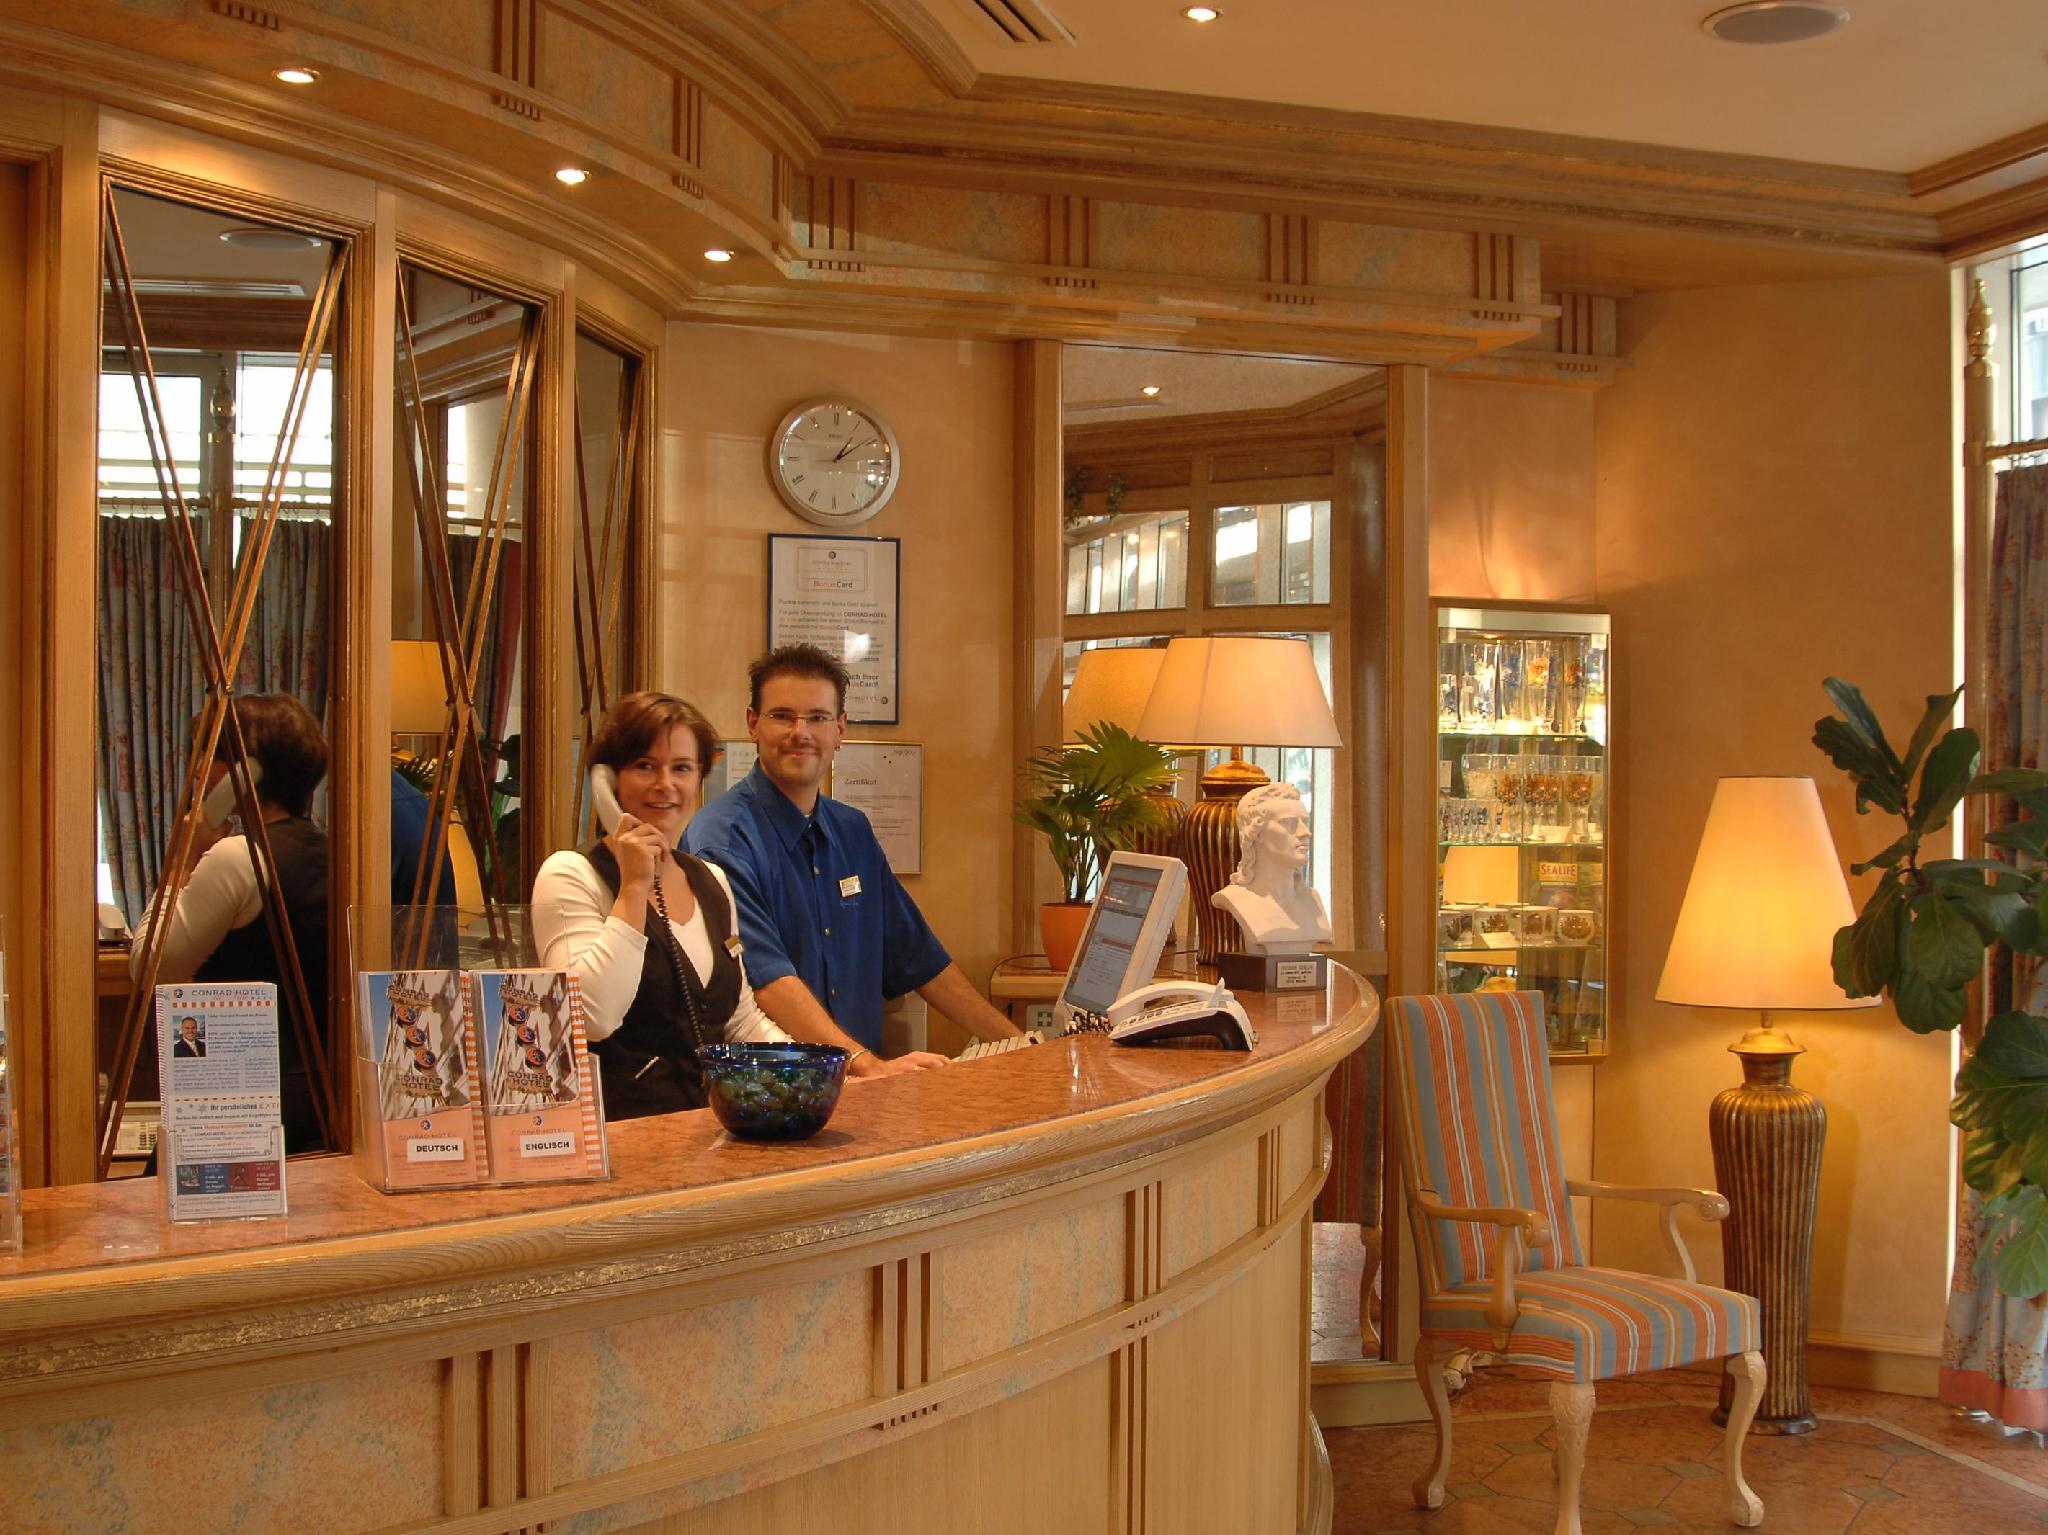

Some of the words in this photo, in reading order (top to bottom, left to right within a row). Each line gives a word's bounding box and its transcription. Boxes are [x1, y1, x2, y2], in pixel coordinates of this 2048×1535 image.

[507, 1071, 554, 1082] CONRAD
[416, 1144, 459, 1153] DEUTSCH
[525, 1141, 570, 1151] ENGLISCH
